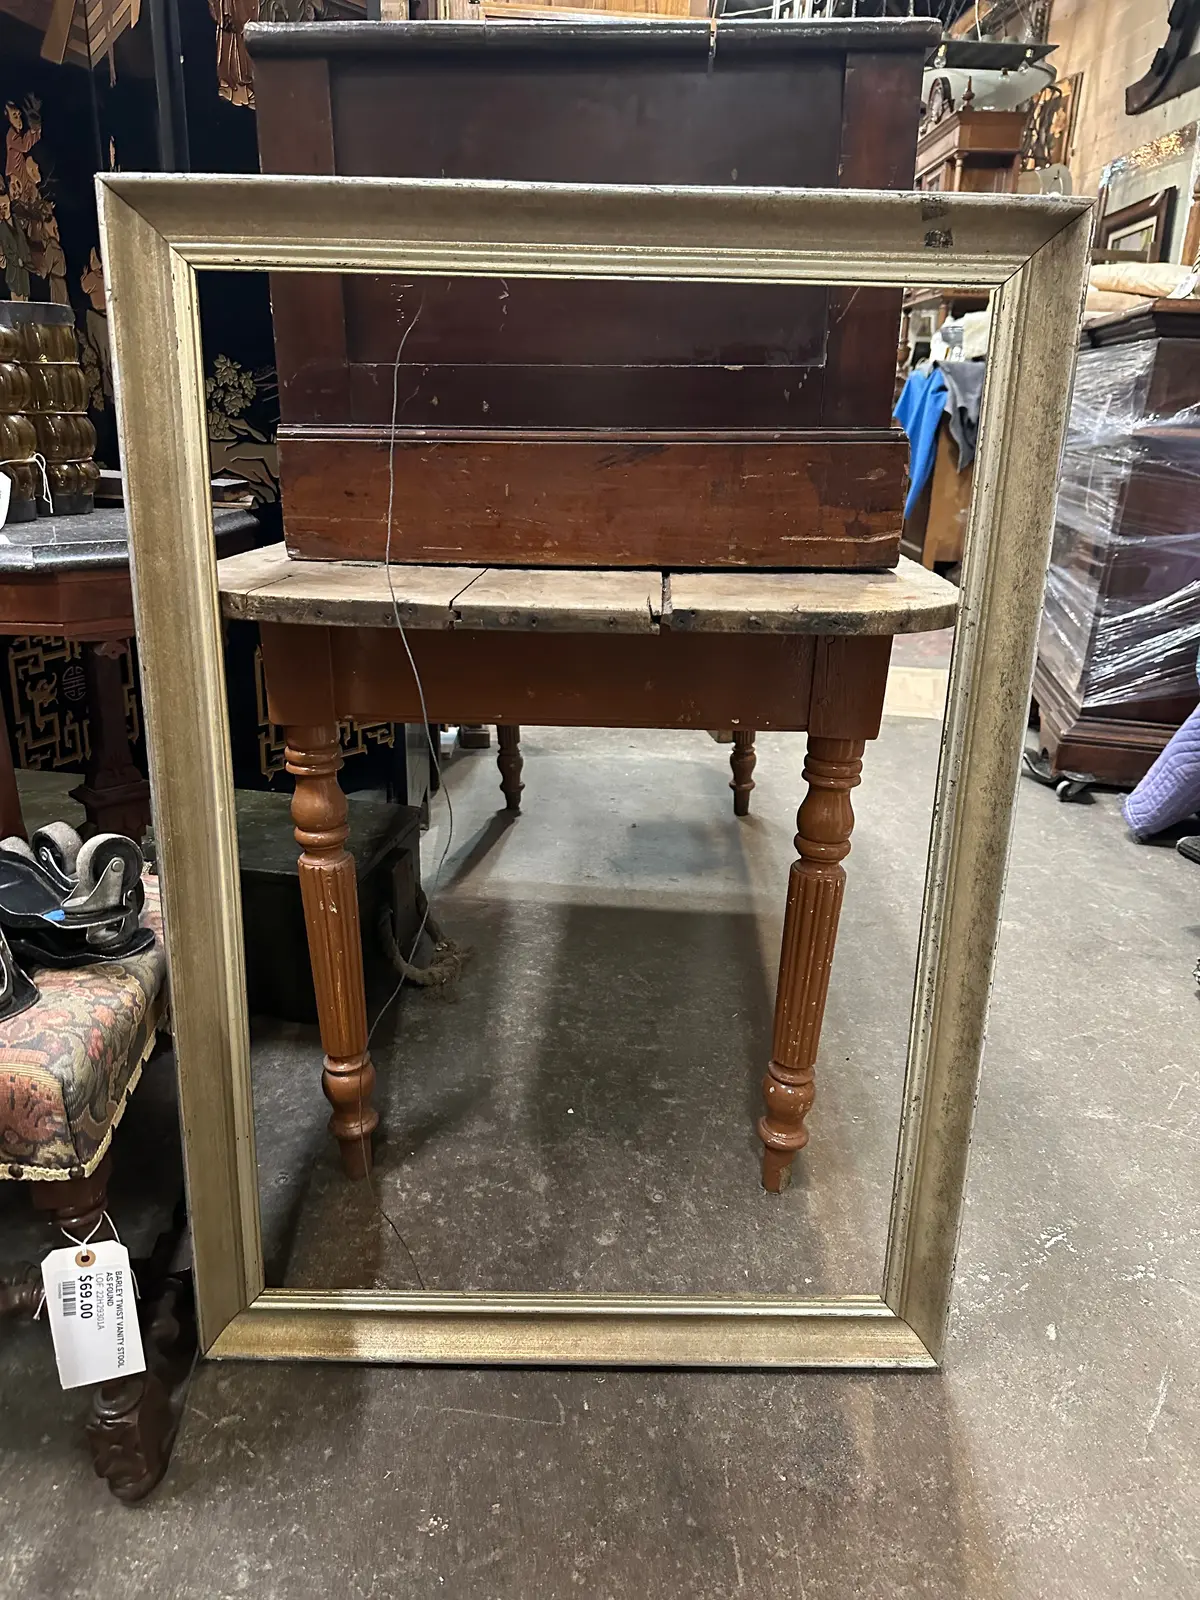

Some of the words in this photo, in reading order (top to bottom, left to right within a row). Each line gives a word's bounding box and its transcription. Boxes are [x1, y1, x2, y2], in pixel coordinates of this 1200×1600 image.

[106, 1272, 113, 1281] AS
[115, 1271, 123, 1296] BARLEY
[78, 1275, 93, 1319] $69.00
